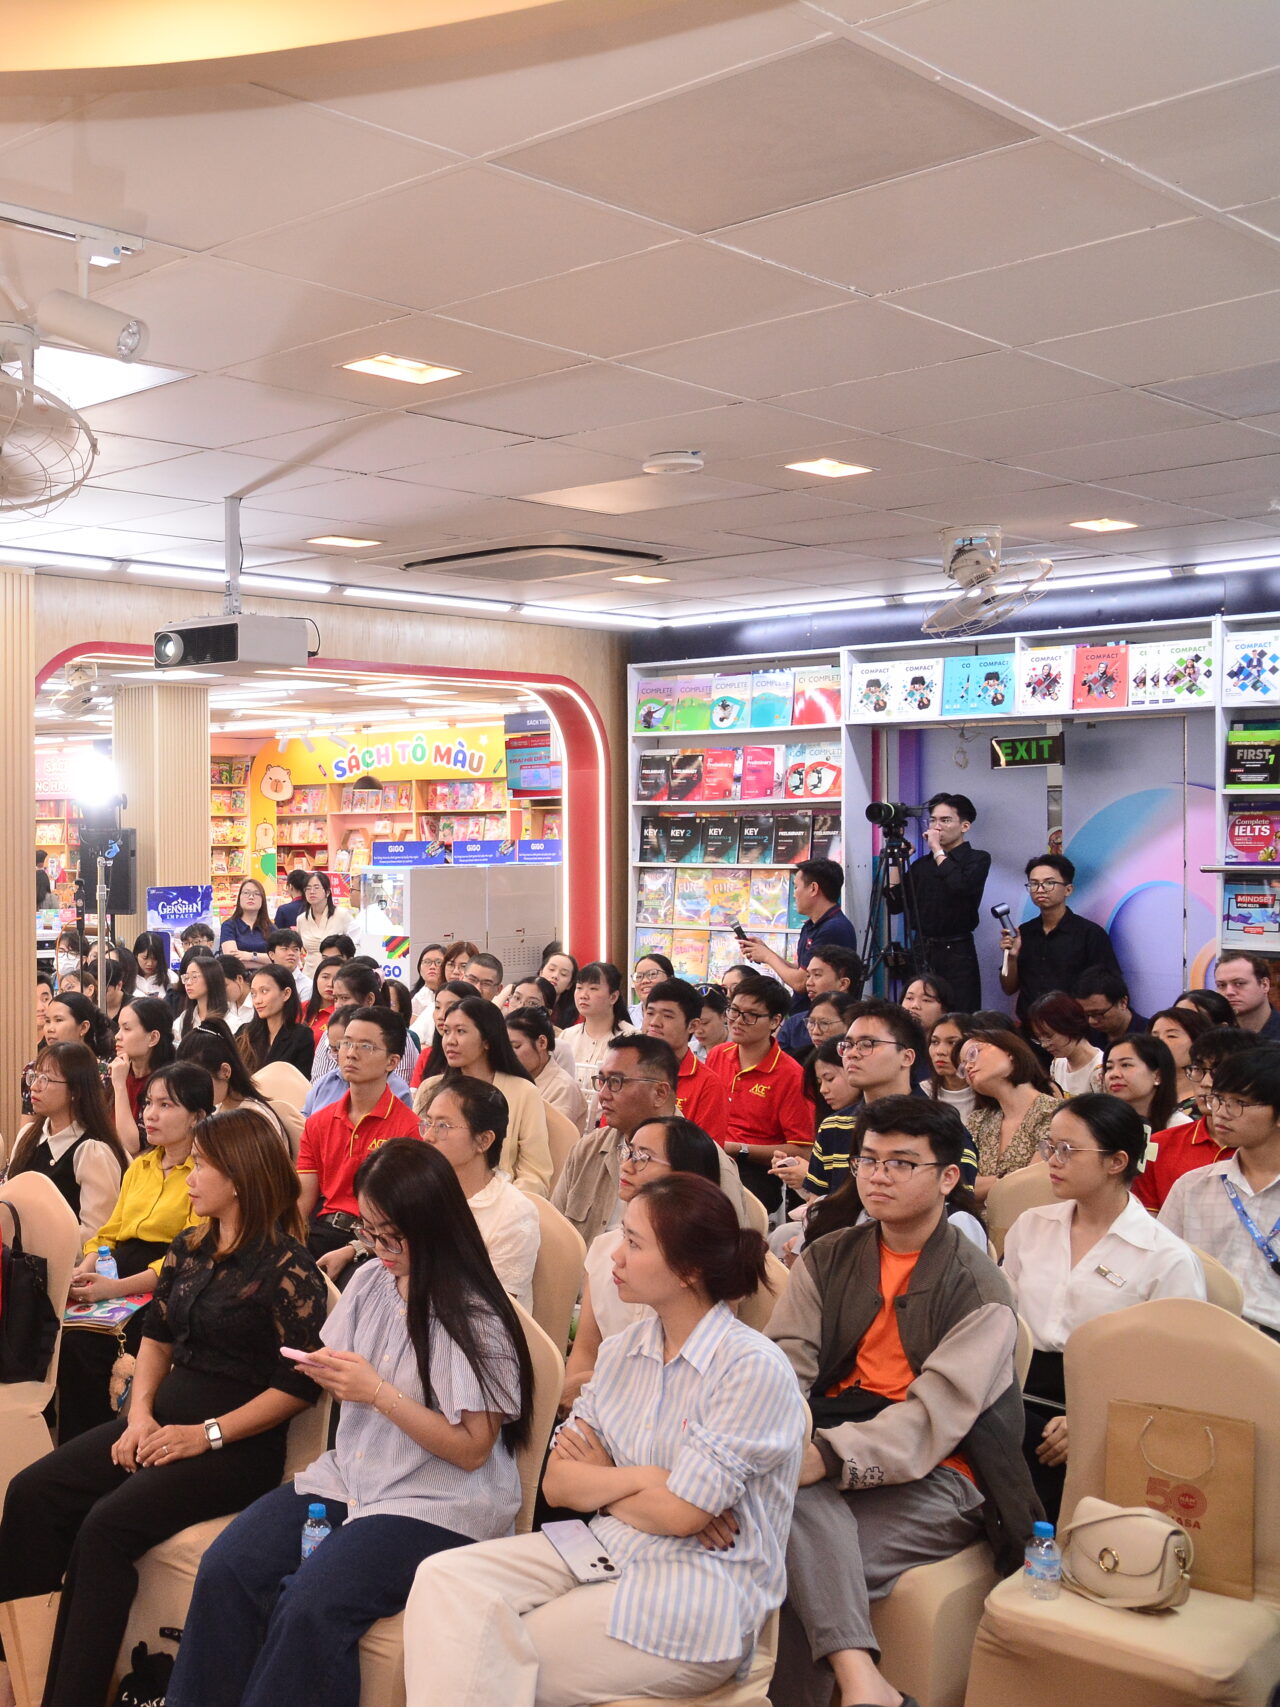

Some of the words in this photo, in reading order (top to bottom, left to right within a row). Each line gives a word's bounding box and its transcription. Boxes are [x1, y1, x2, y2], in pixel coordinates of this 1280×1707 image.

[1170, 645, 1207, 654] COMPACT
[1234, 641, 1272, 650] COMPACT
[905, 664, 934, 672] COMPACT
[978, 660, 1009, 668] COMPACT
[680, 685, 713, 694] COMPLETE
[715, 681, 749, 690] COMPLETE
[641, 687, 673, 695] COMPLETE
[1000, 739, 1053, 761] EXIT
[333, 746, 391, 779] SÁCH
[396, 735, 427, 763] TÔ
[433, 740, 485, 773] MÀU
[1236, 748, 1272, 760] FIRST
[1268, 754, 1275, 765] 1
[1235, 818, 1270, 826] Complete
[643, 828, 658, 837] KEY
[670, 829, 685, 837] KEY
[686, 829, 692, 837] 2
[708, 827, 724, 836] KEY
[744, 827, 759, 836] KEY
[1234, 825, 1271, 836] IELTS
[678, 882, 696, 893] FUN
[713, 882, 734, 893] FUN
[1237, 895, 1274, 903] MINDSET
[158, 898, 202, 915] GENSHIN
[750, 1083, 768, 1096] ACE
[1145, 1477, 1208, 1519] 50
[1171, 1516, 1201, 1530] ASA
